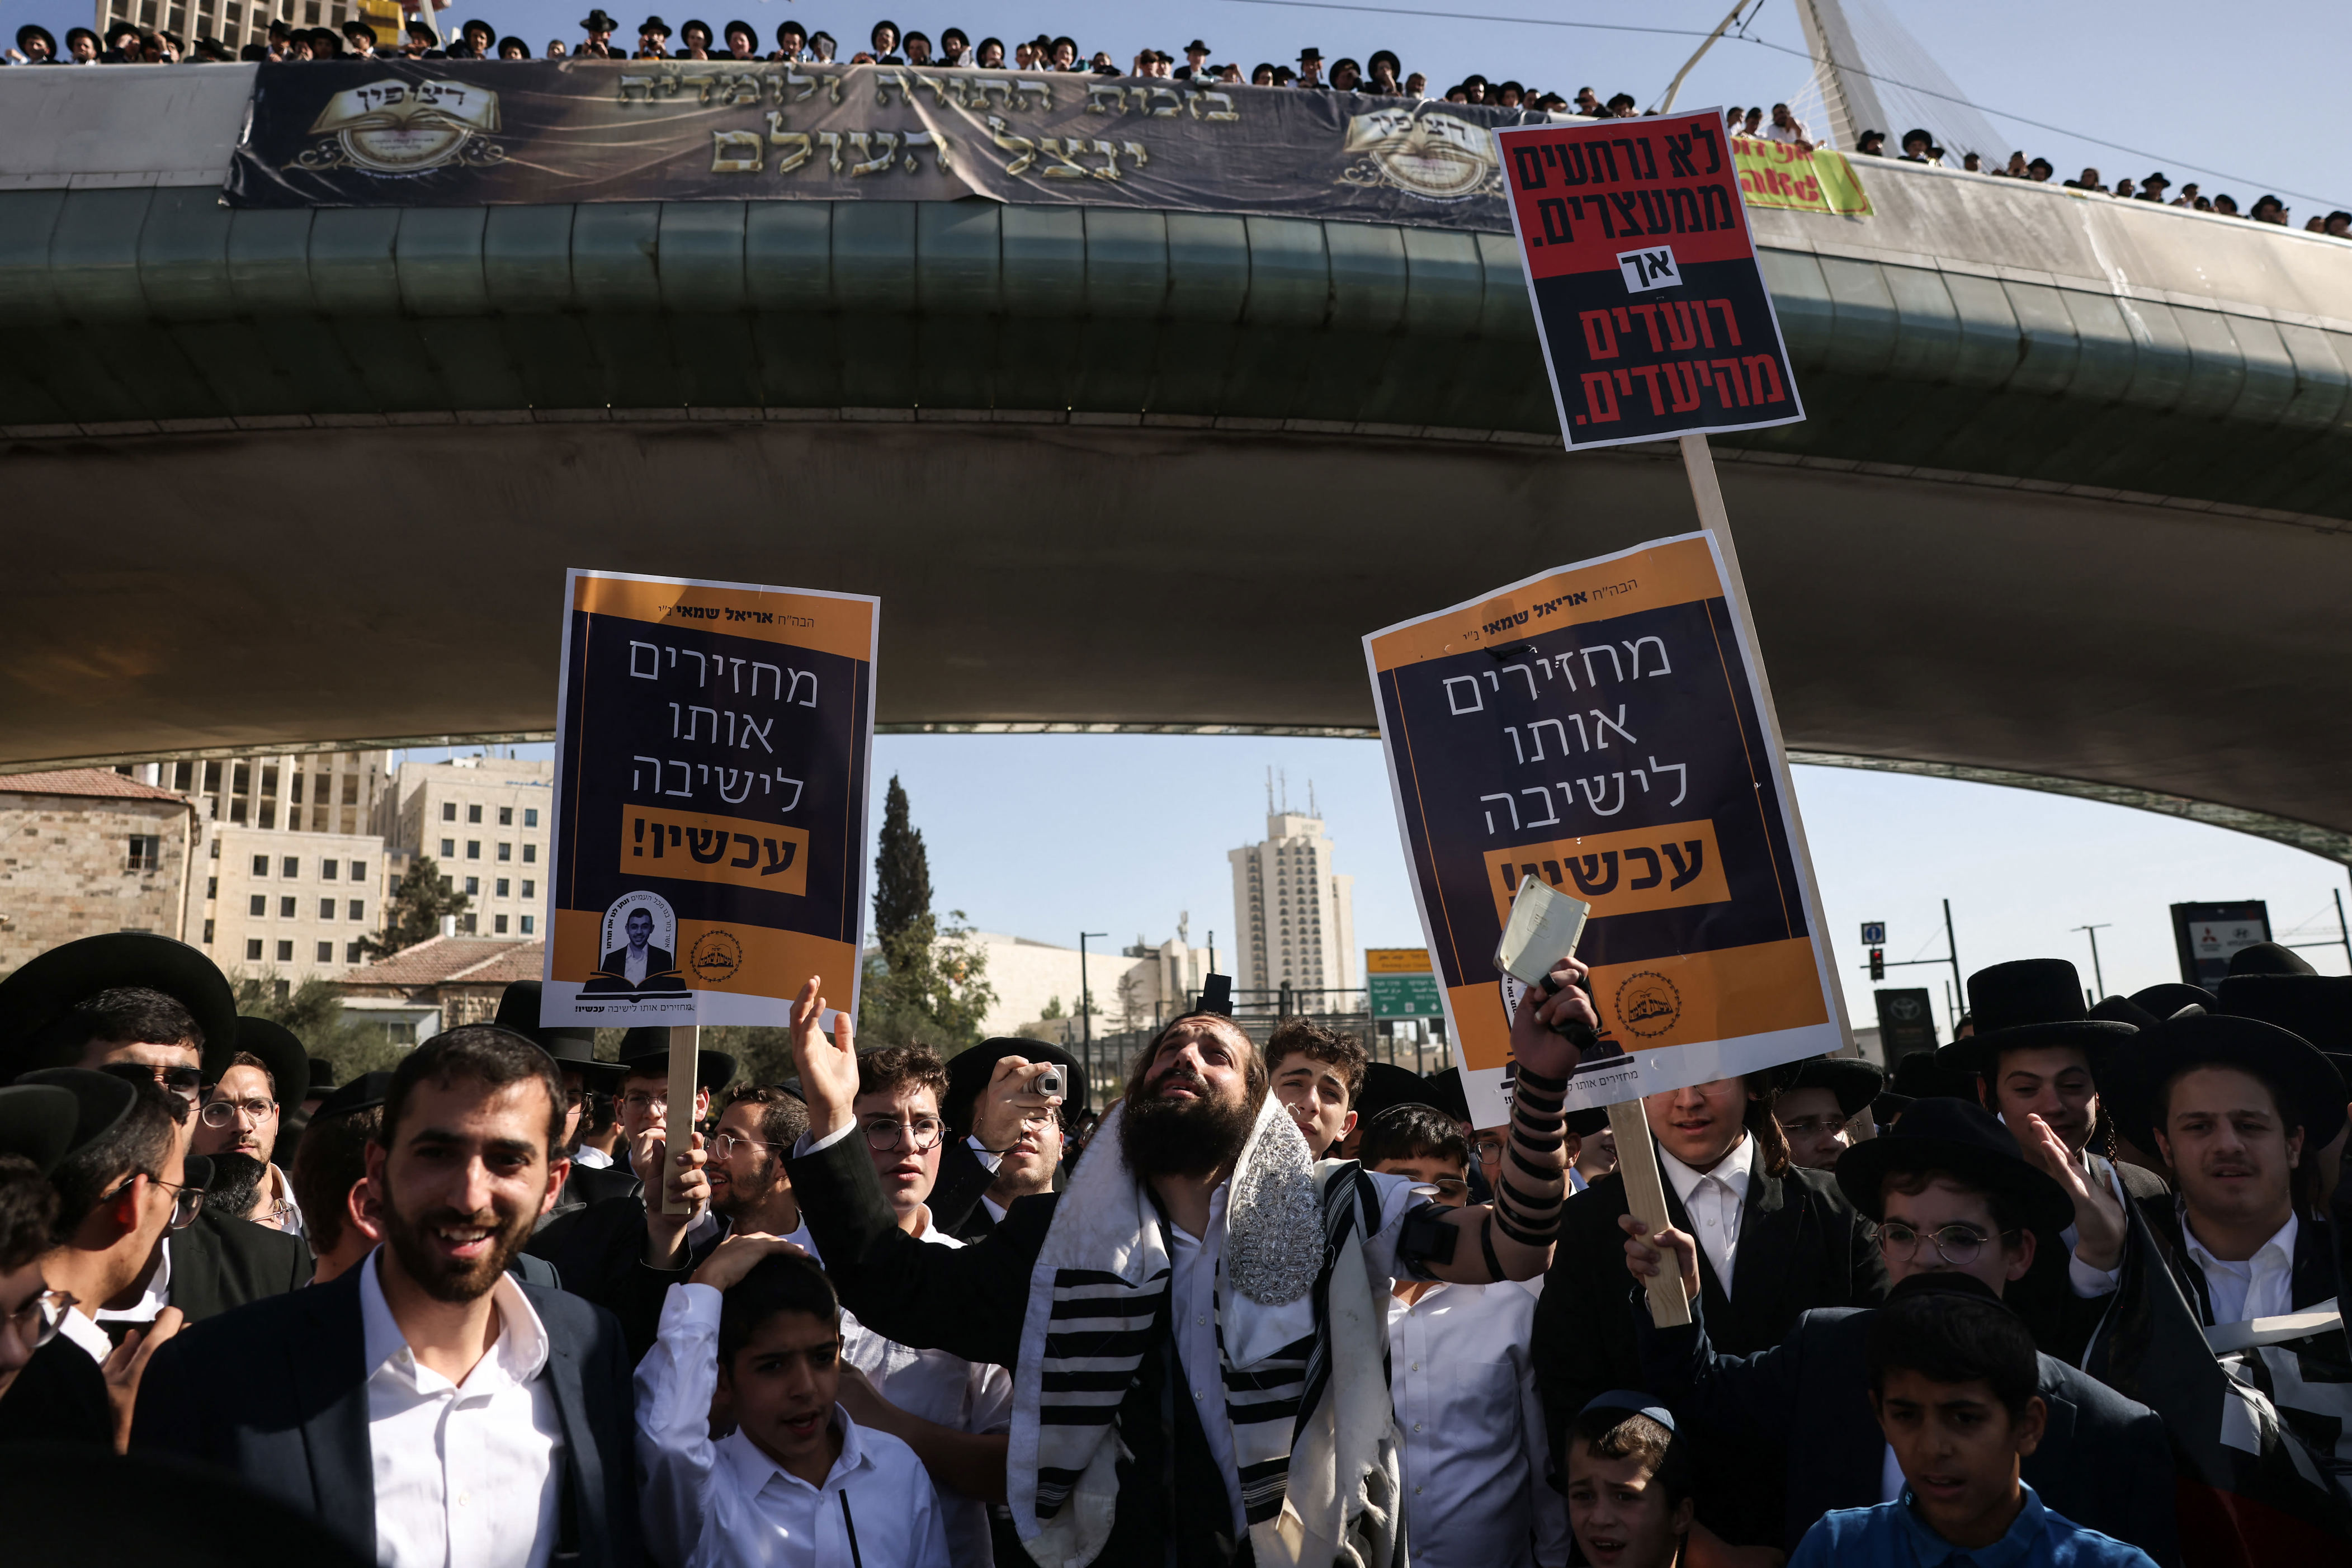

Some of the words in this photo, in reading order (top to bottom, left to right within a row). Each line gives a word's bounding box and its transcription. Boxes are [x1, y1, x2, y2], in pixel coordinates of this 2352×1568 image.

[619, 63, 841, 105] ולומדיה
[876, 73, 1052, 111] התורה
[1087, 82, 1239, 122] בזכות
[711, 111, 951, 177] העולם
[988, 116, 1147, 180] ינצל
[1513, 138, 1658, 190] נרתעים
[1668, 124, 1721, 178] לא
[1533, 183, 1735, 247] ממעצרים.
[1622, 251, 1674, 287] אך
[1579, 299, 1742, 360] רועדים
[1576, 353, 1786, 425] מהיעדים.
[677, 606, 720, 620] שמאי
[725, 607, 773, 624] אריאל
[1482, 609, 1529, 636] שמאי
[1533, 590, 1588, 619] אריאל
[630, 640, 818, 708] מחזירים
[1443, 636, 1671, 715] מחזירים
[669, 702, 773, 753] אותו
[1505, 704, 1637, 765] אותו
[633, 755, 804, 812] לישיבה
[1480, 756, 1686, 835] לישיבה
[633, 818, 797, 876] עכשיו!
[608, 919, 613, 929] את
[653, 898, 664, 909] מכל
[1508, 986, 1514, 998] את
[1576, 1080, 1597, 1090] אותו
[1599, 1070, 1638, 1086] מחזירים
